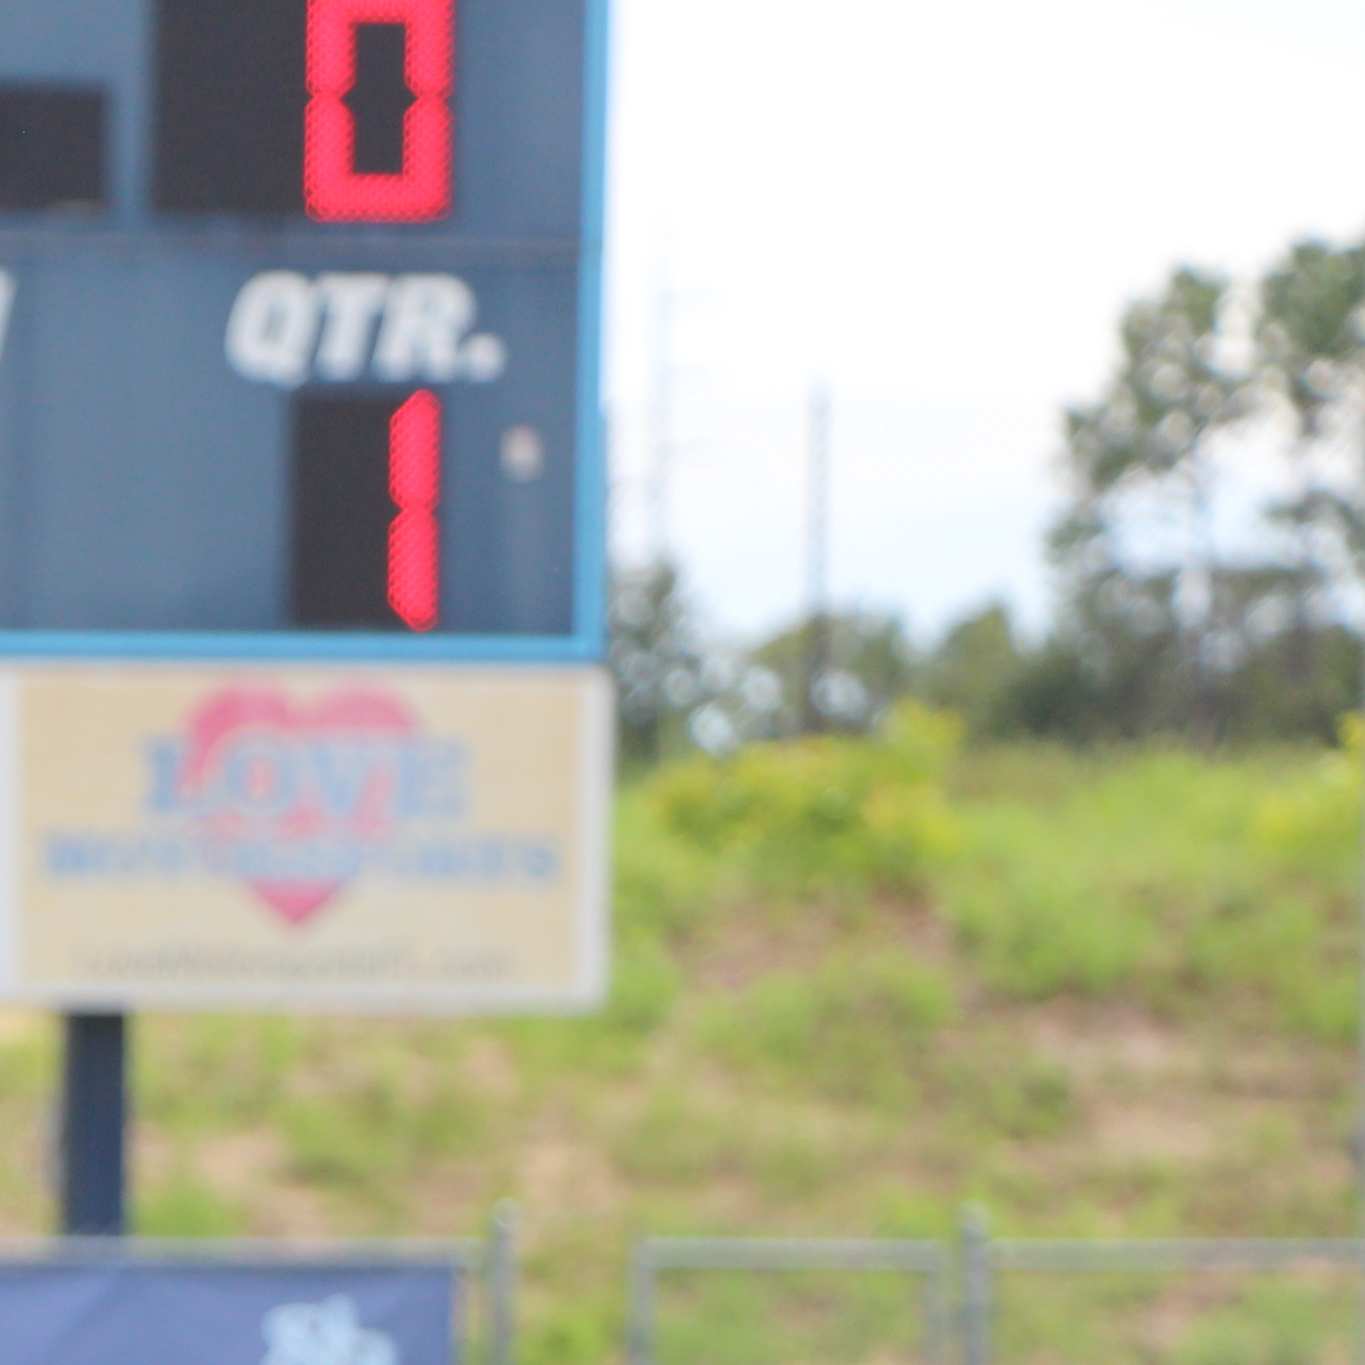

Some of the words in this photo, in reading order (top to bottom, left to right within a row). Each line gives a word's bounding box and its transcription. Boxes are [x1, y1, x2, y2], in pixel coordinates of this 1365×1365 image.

[303, 0, 455, 223] 0
[224, 271, 507, 389] QTR.
[387, 388, 442, 633] 1
[139, 732, 473, 826] LOVE
